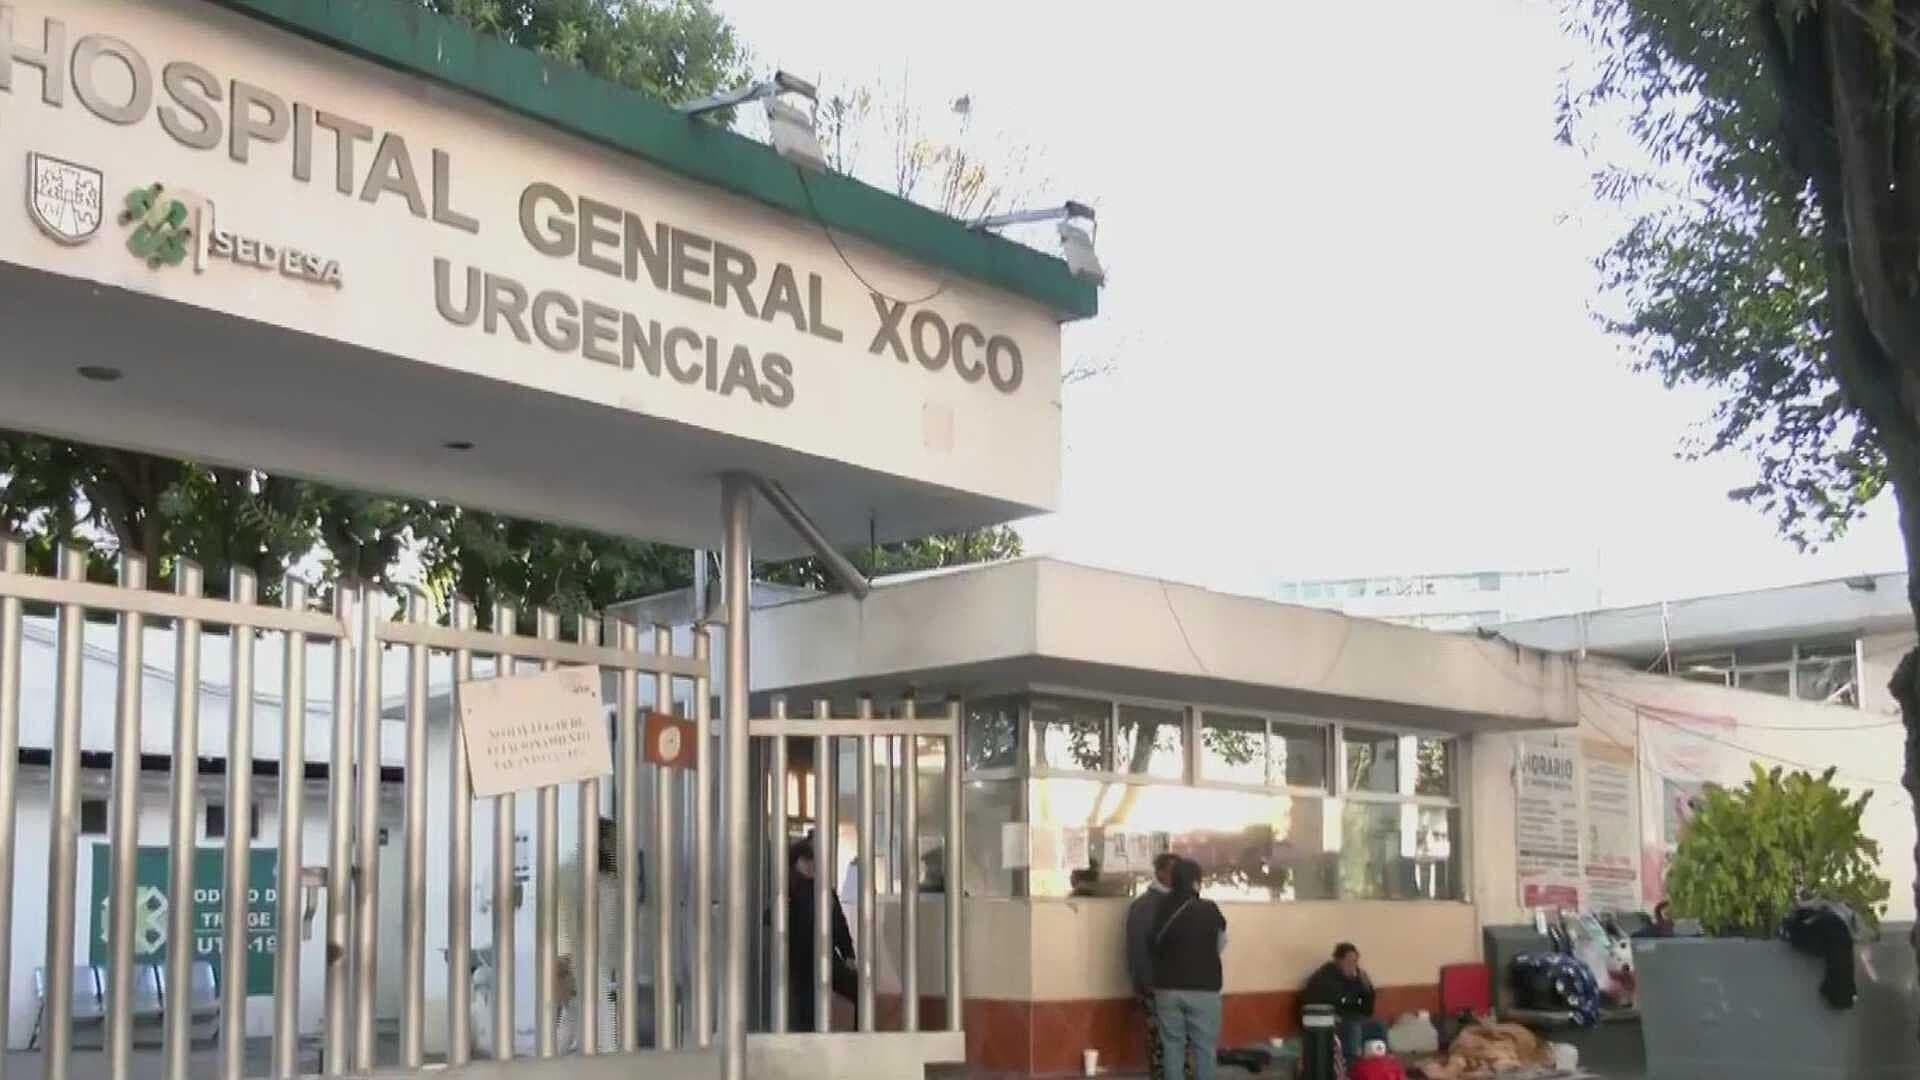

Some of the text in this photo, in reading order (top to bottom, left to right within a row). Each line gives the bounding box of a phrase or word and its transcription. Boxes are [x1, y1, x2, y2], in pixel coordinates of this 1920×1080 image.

[0, 5, 1023, 394] HOSPITAL GENERAL XOCO
[210, 228, 344, 290] SEDESA
[433, 256, 796, 408] URGENCIAS
[200, 912, 271, 928] TRGE
